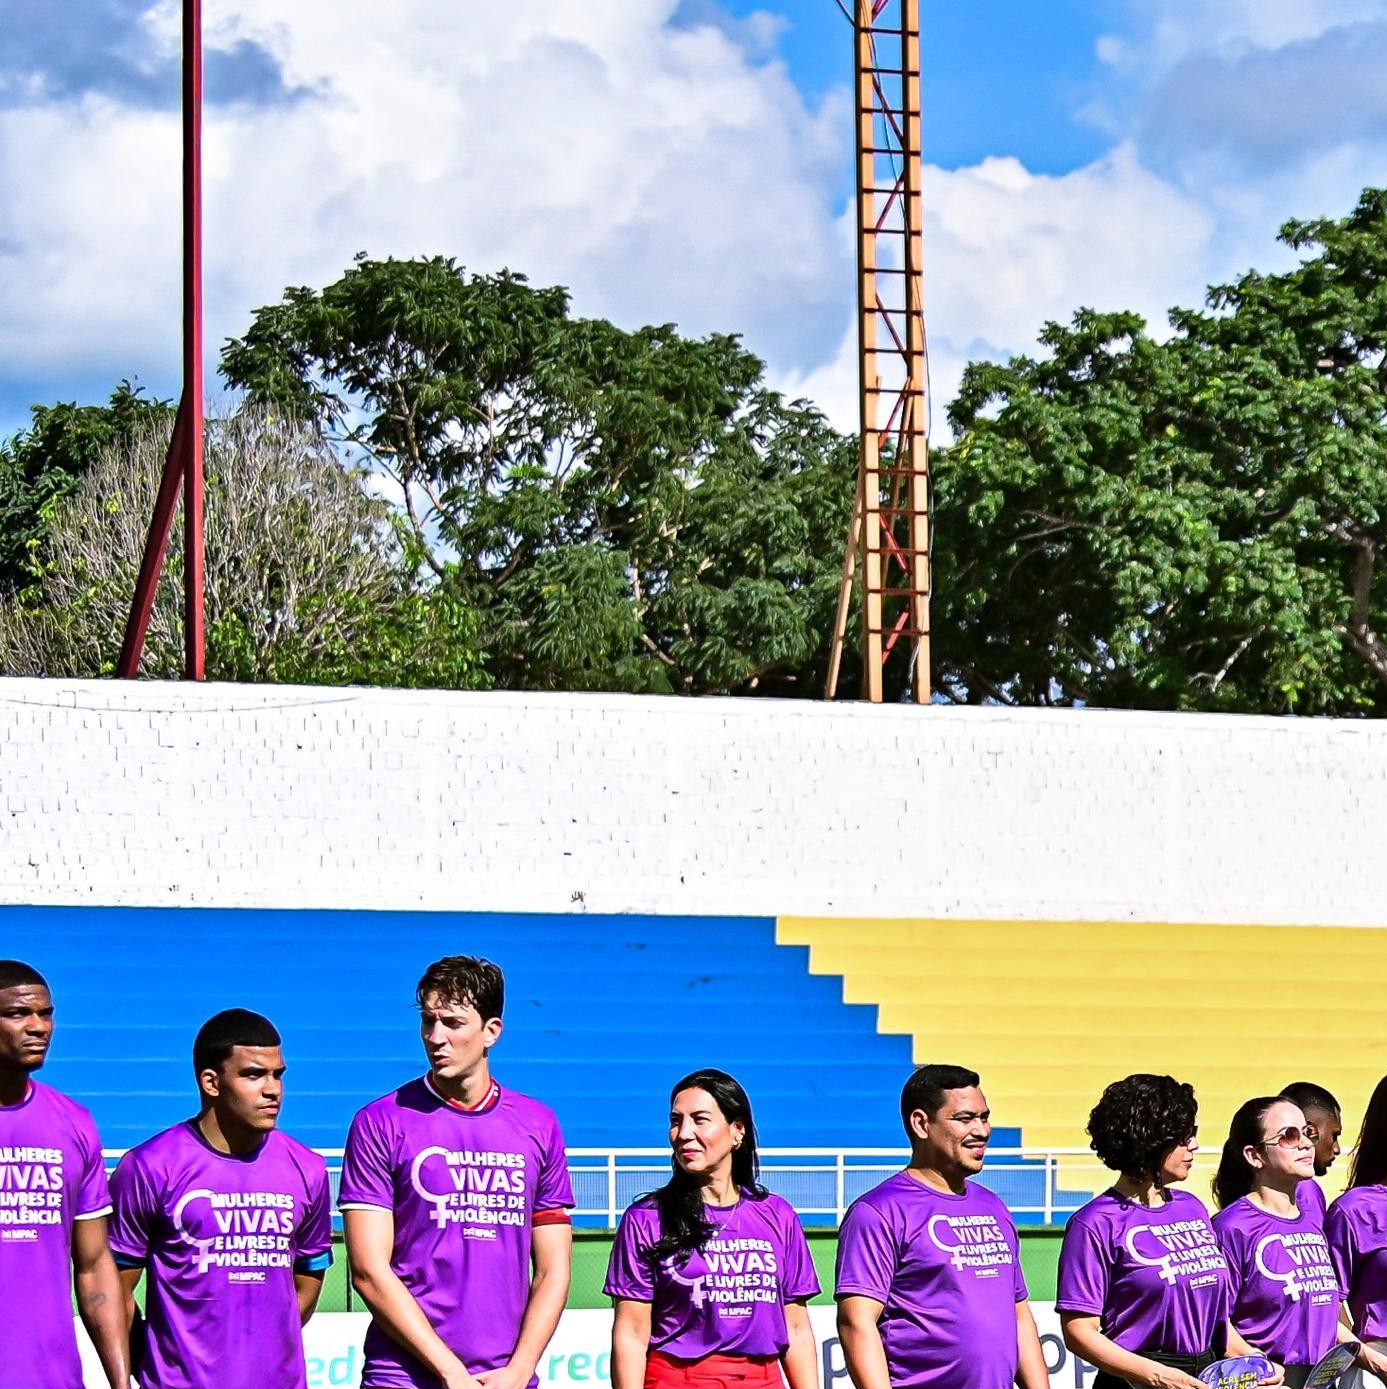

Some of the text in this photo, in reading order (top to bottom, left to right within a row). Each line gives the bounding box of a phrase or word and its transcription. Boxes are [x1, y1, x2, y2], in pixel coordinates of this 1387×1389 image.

[0, 1147, 63, 1164] ULHERES
[445, 1150, 525, 1168] MULHERES
[449, 1168, 525, 1193] VIVAS
[212, 1193, 295, 1209] MULHERES
[213, 1210, 295, 1233] VIVAS
[946, 1216, 997, 1226] MULHERES
[1149, 1219, 1207, 1235] MULHERES
[953, 1226, 1005, 1243] VIVAS
[1158, 1230, 1217, 1251] VIVAS
[703, 1252, 777, 1273] VIVAS
